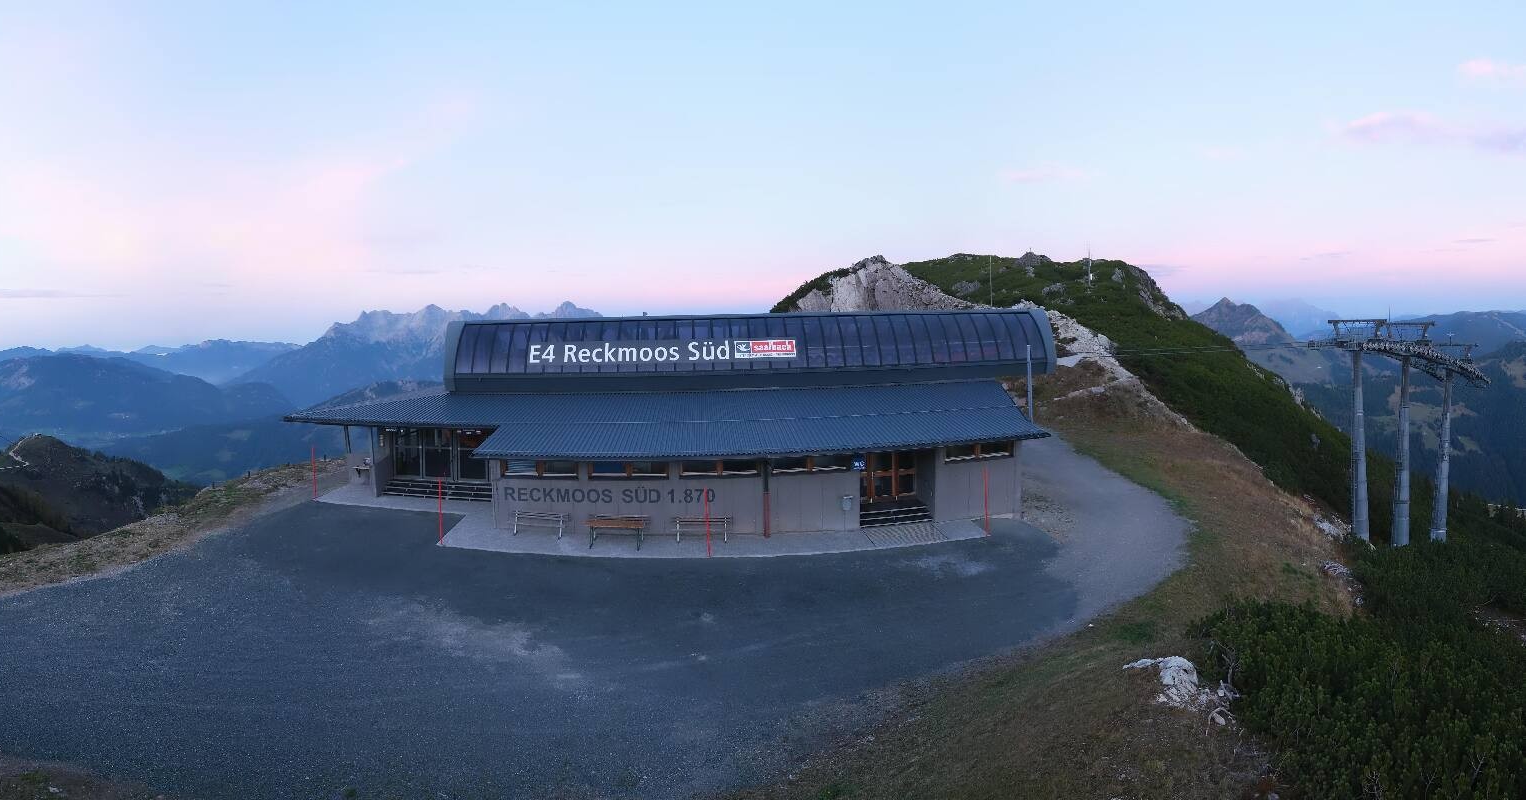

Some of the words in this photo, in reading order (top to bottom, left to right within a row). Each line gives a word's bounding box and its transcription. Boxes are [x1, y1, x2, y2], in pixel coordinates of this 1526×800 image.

[529, 344, 555, 363] E4
[563, 343, 680, 363] Reckmoos
[687, 340, 730, 361] Süd
[503, 486, 613, 504] RECKMOOS
[621, 486, 661, 504] SÜD
[667, 488, 716, 504] 1.870
